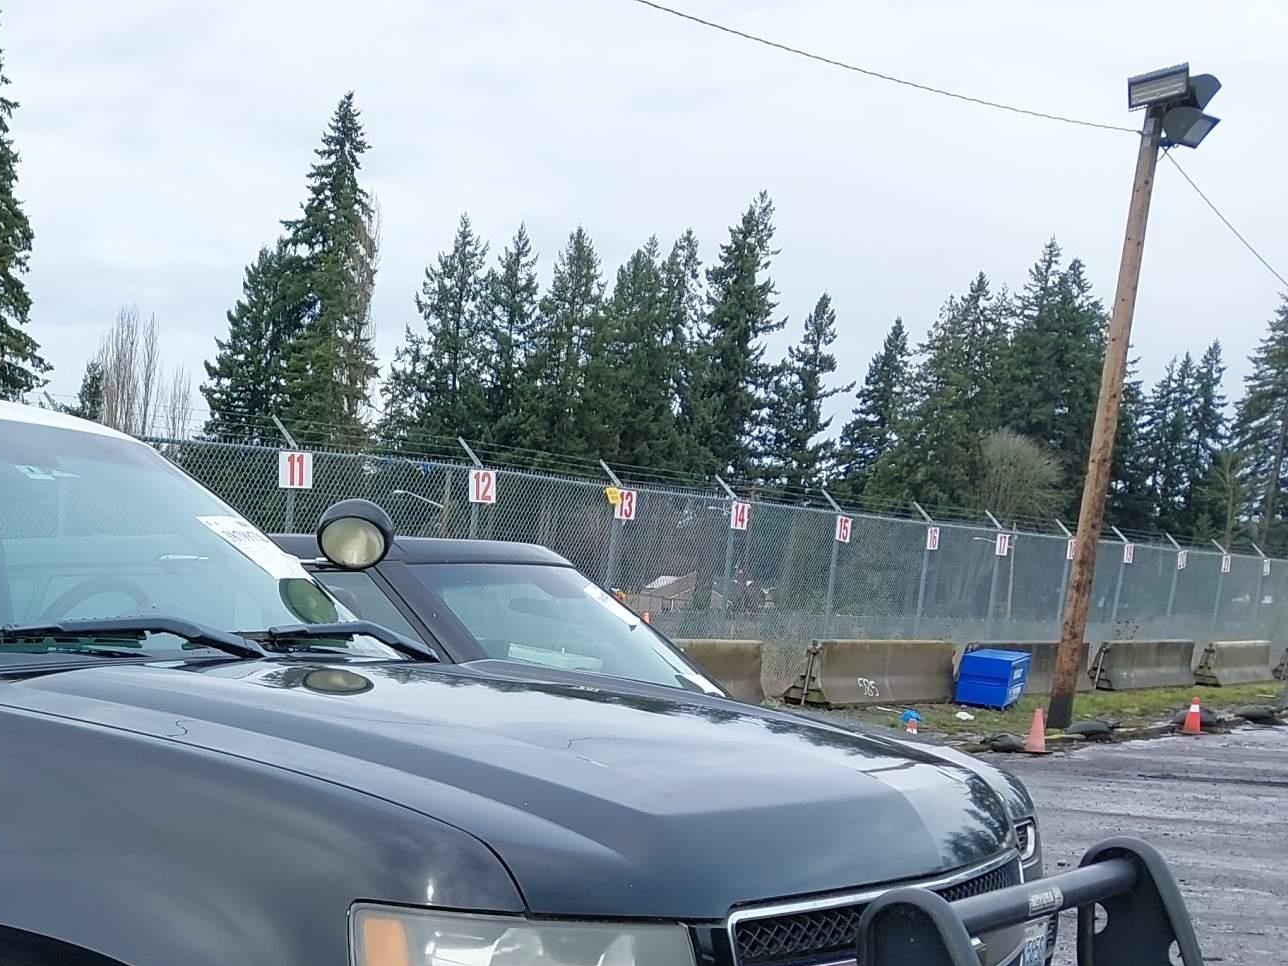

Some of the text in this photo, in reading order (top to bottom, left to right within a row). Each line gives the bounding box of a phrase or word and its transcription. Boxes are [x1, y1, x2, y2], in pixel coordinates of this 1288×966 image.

[287, 453, 304, 486] 11
[473, 472, 492, 501] 12
[618, 492, 634, 518] 13
[733, 504, 746, 528] 14
[838, 518, 849, 541] 15
[928, 529, 938, 549] 16
[997, 535, 1007, 555] 17
[857, 677, 880, 697] 585
